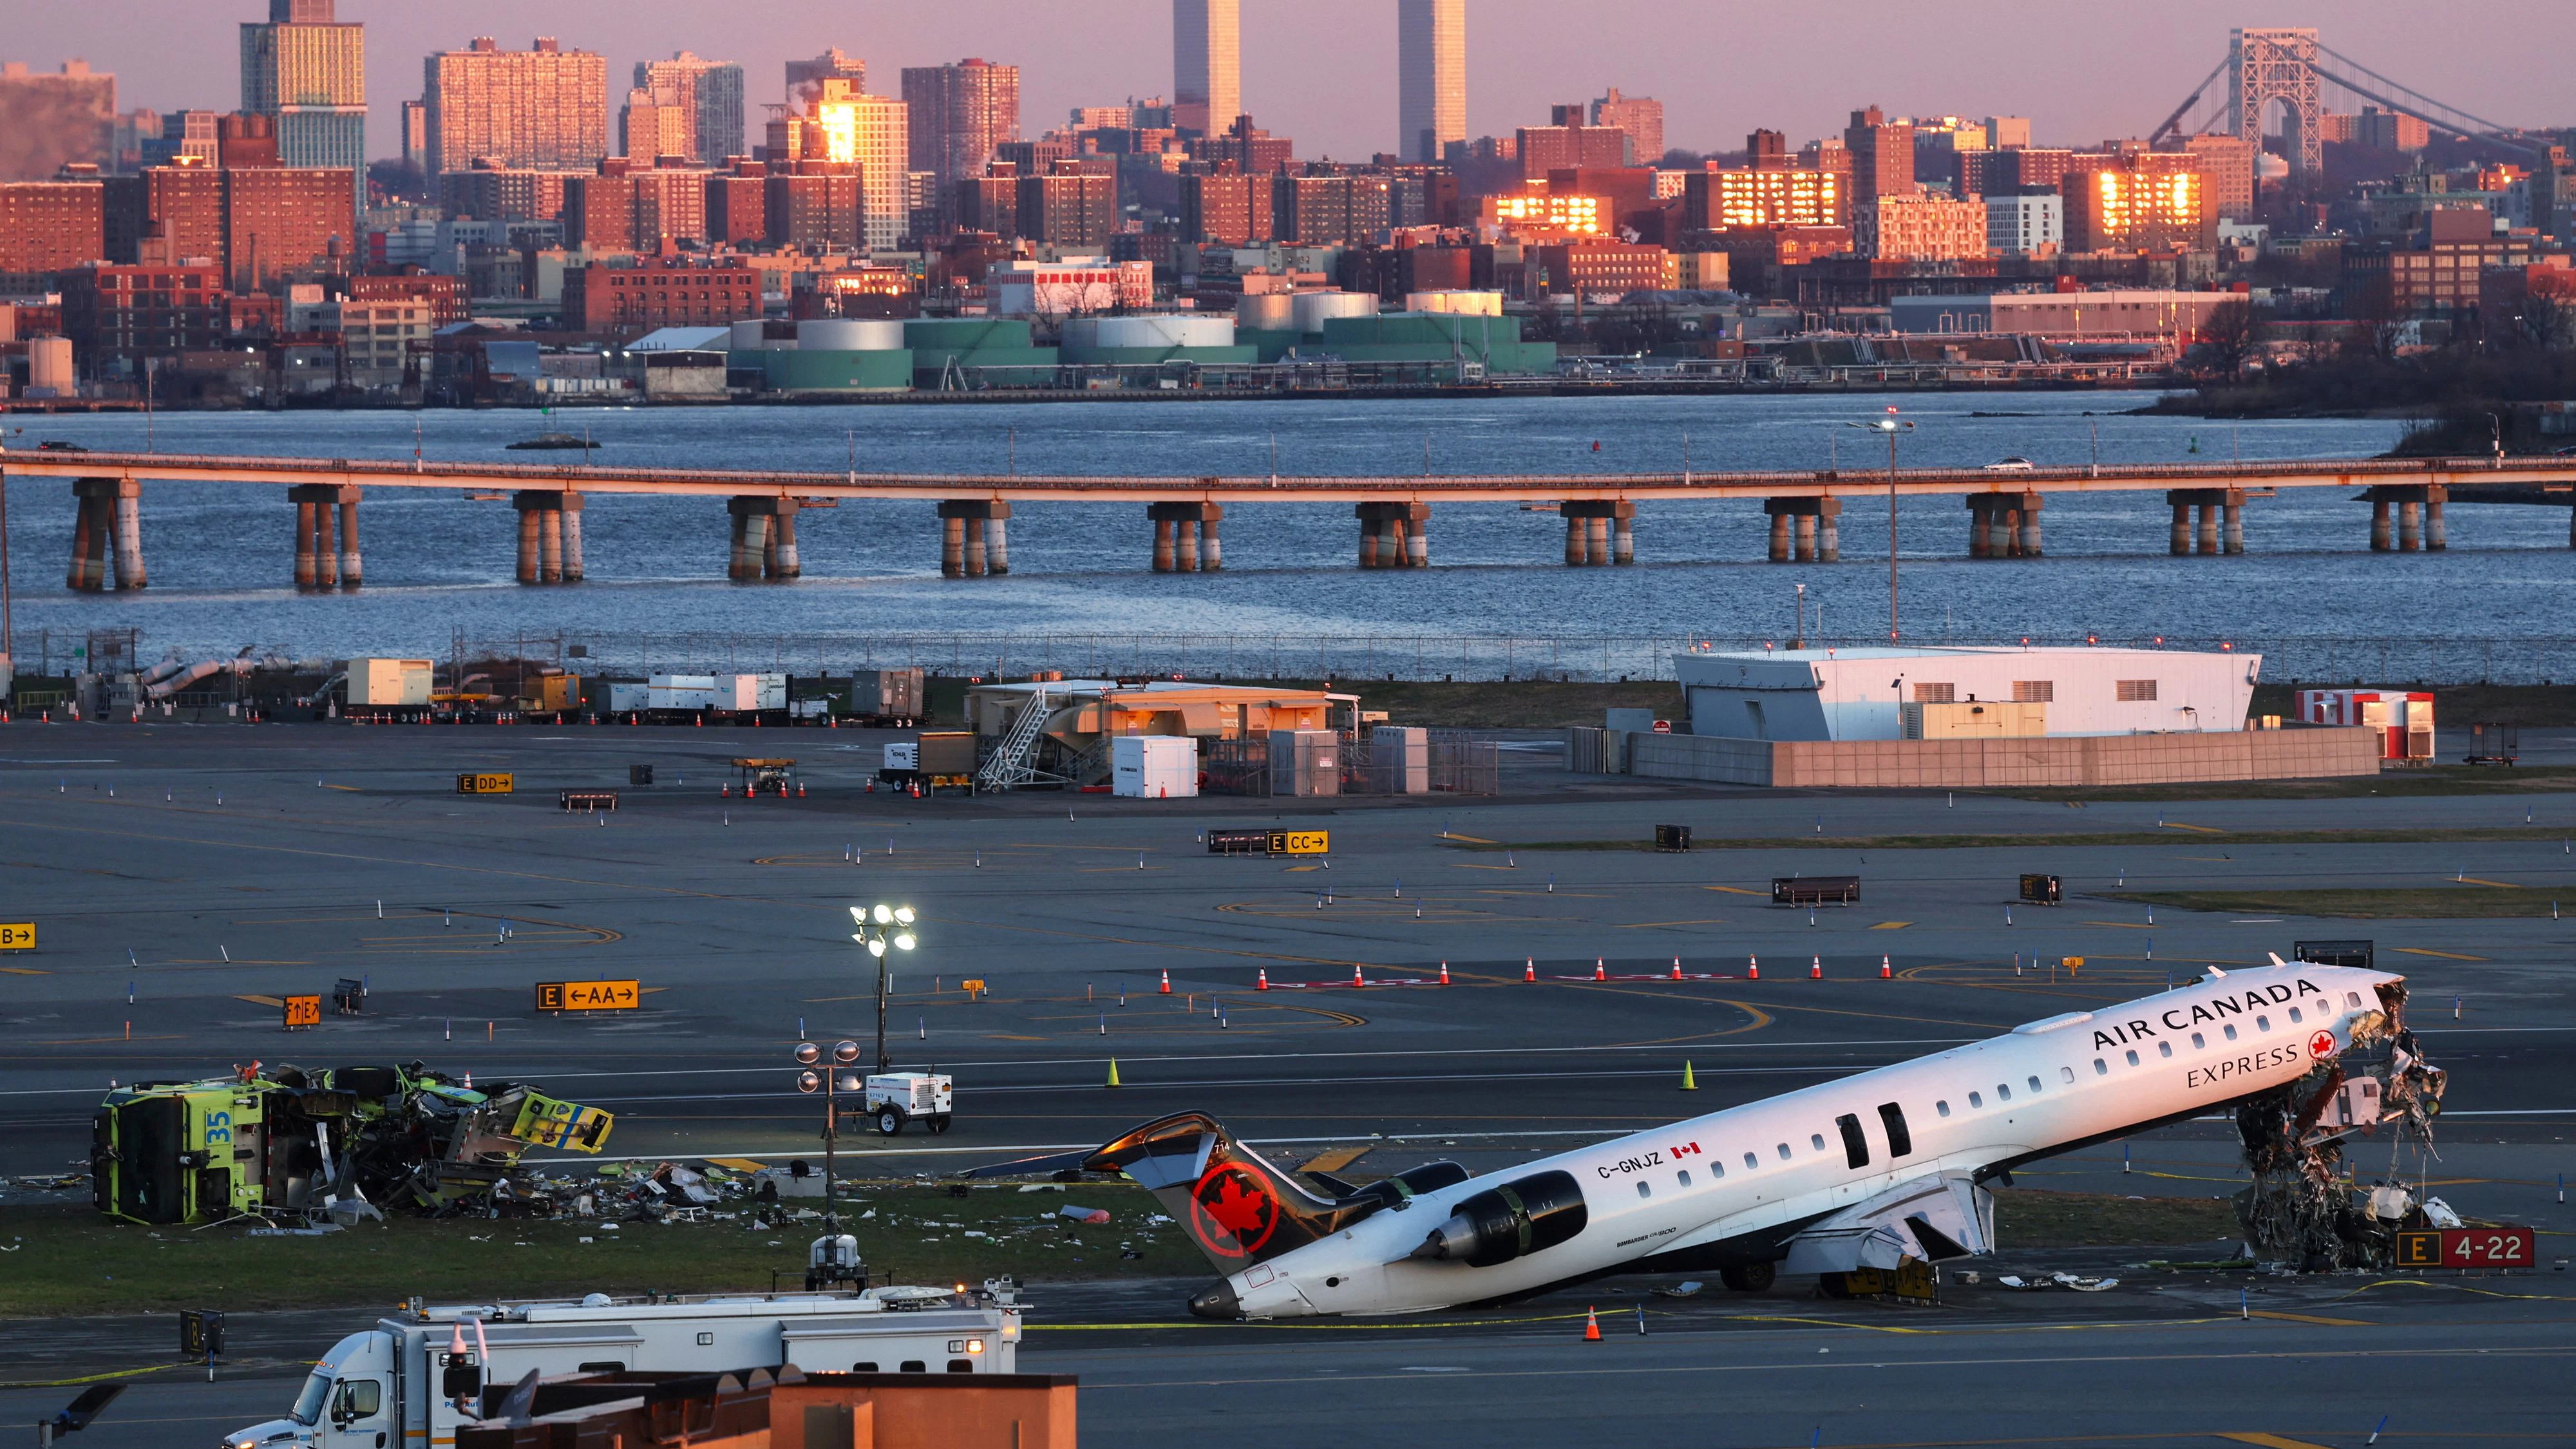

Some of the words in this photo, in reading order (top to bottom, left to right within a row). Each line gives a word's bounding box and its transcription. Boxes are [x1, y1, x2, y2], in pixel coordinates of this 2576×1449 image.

[464, 778, 471, 790] E
[479, 777, 497, 789] DD
[1273, 837, 1282, 850] E
[1291, 836, 1310, 849] CC
[3, 929, 13, 944] B
[545, 988, 556, 1005] E
[588, 987, 616, 1004] AA
[287, 1003, 293, 1019] F
[305, 1002, 310, 1019] E
[2093, 1019, 2157, 1050] AIR
[2162, 979, 2322, 1030] CANADA
[2188, 1044, 2298, 1088] EXPRESS
[207, 1112, 229, 1144] 35
[1215, 1142, 1230, 1153] 714
[1598, 1151, 1663, 1179] C-GNJZ
[1617, 1235, 1649, 1248] BOMBARDIER
[2412, 1237, 2426, 1260] E
[2455, 1235, 2521, 1260] 4-22
[193, 1322, 198, 1346] B
